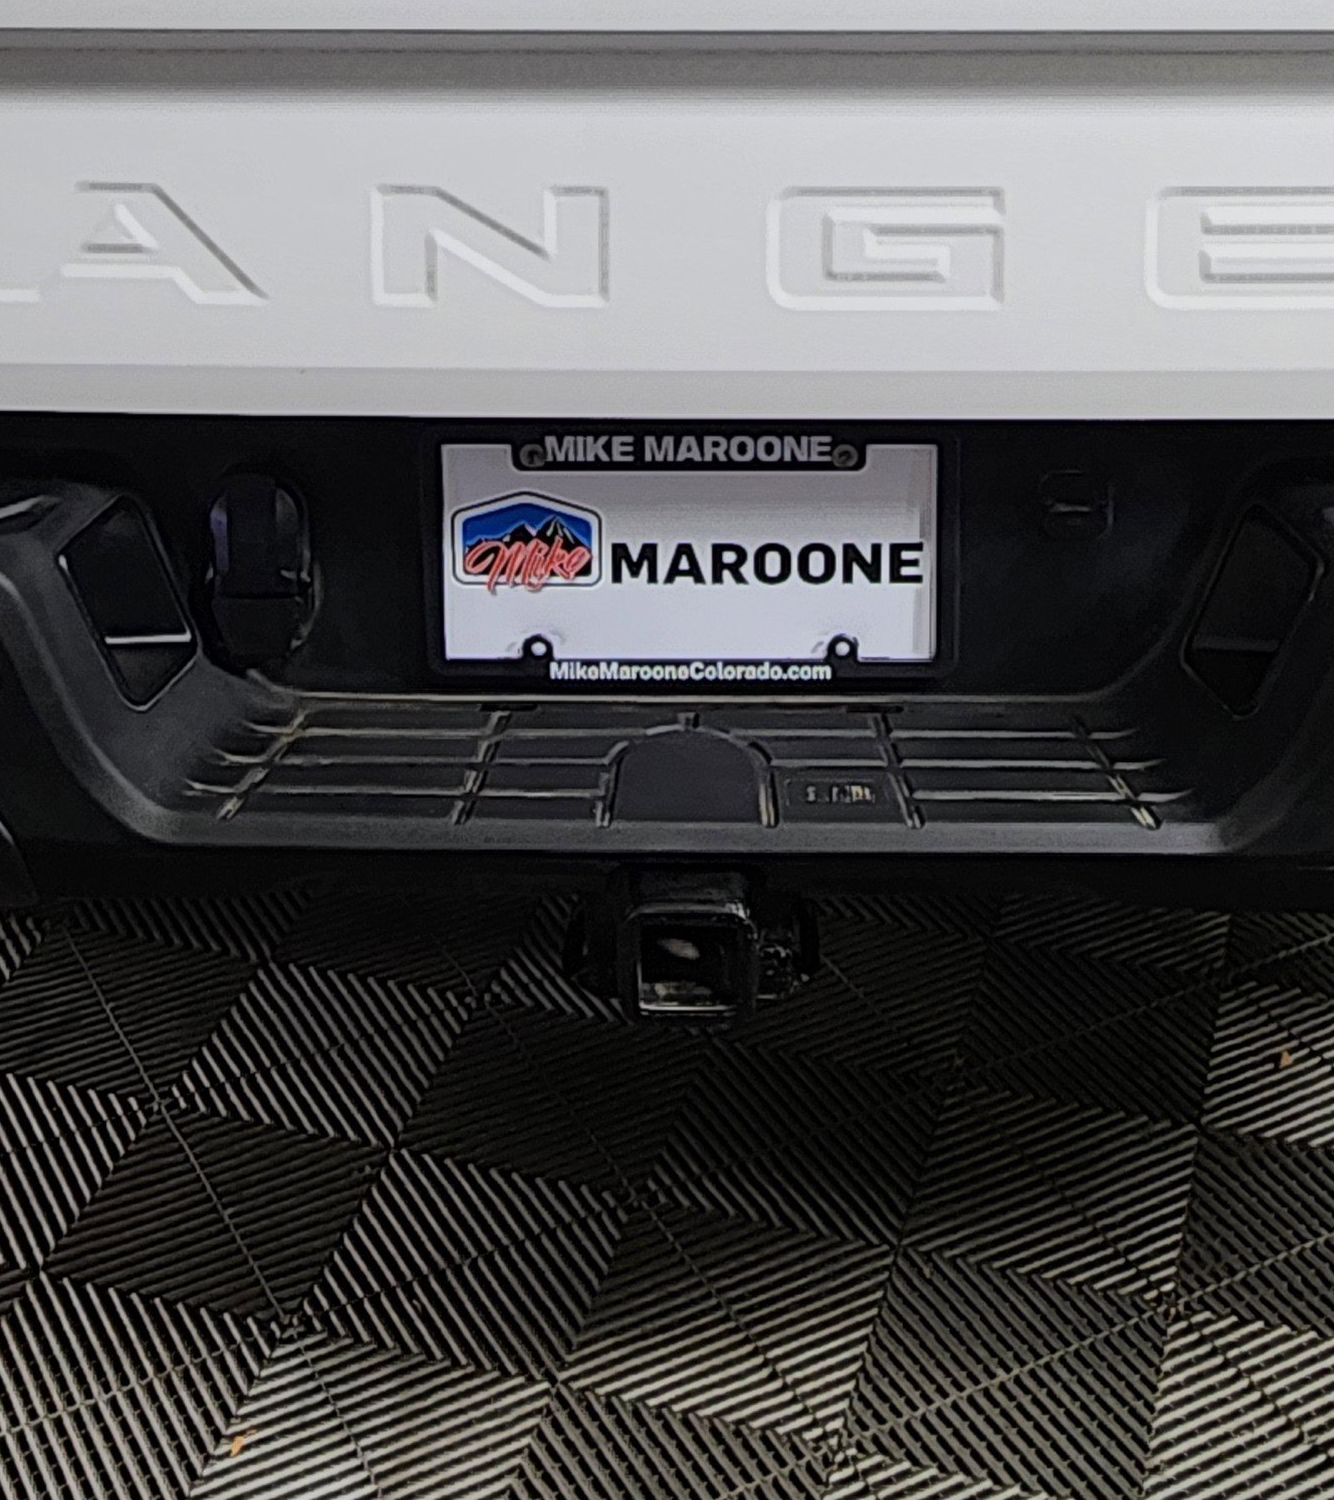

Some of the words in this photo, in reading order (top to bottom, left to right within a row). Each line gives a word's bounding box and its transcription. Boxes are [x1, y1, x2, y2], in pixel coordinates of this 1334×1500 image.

[544, 435, 635, 463] MIKE
[643, 435, 833, 463] MAROONE
[465, 536, 592, 594] Mike
[610, 542, 924, 585] MAROONE
[549, 661, 832, 681] MikeMarooneColorado.com
